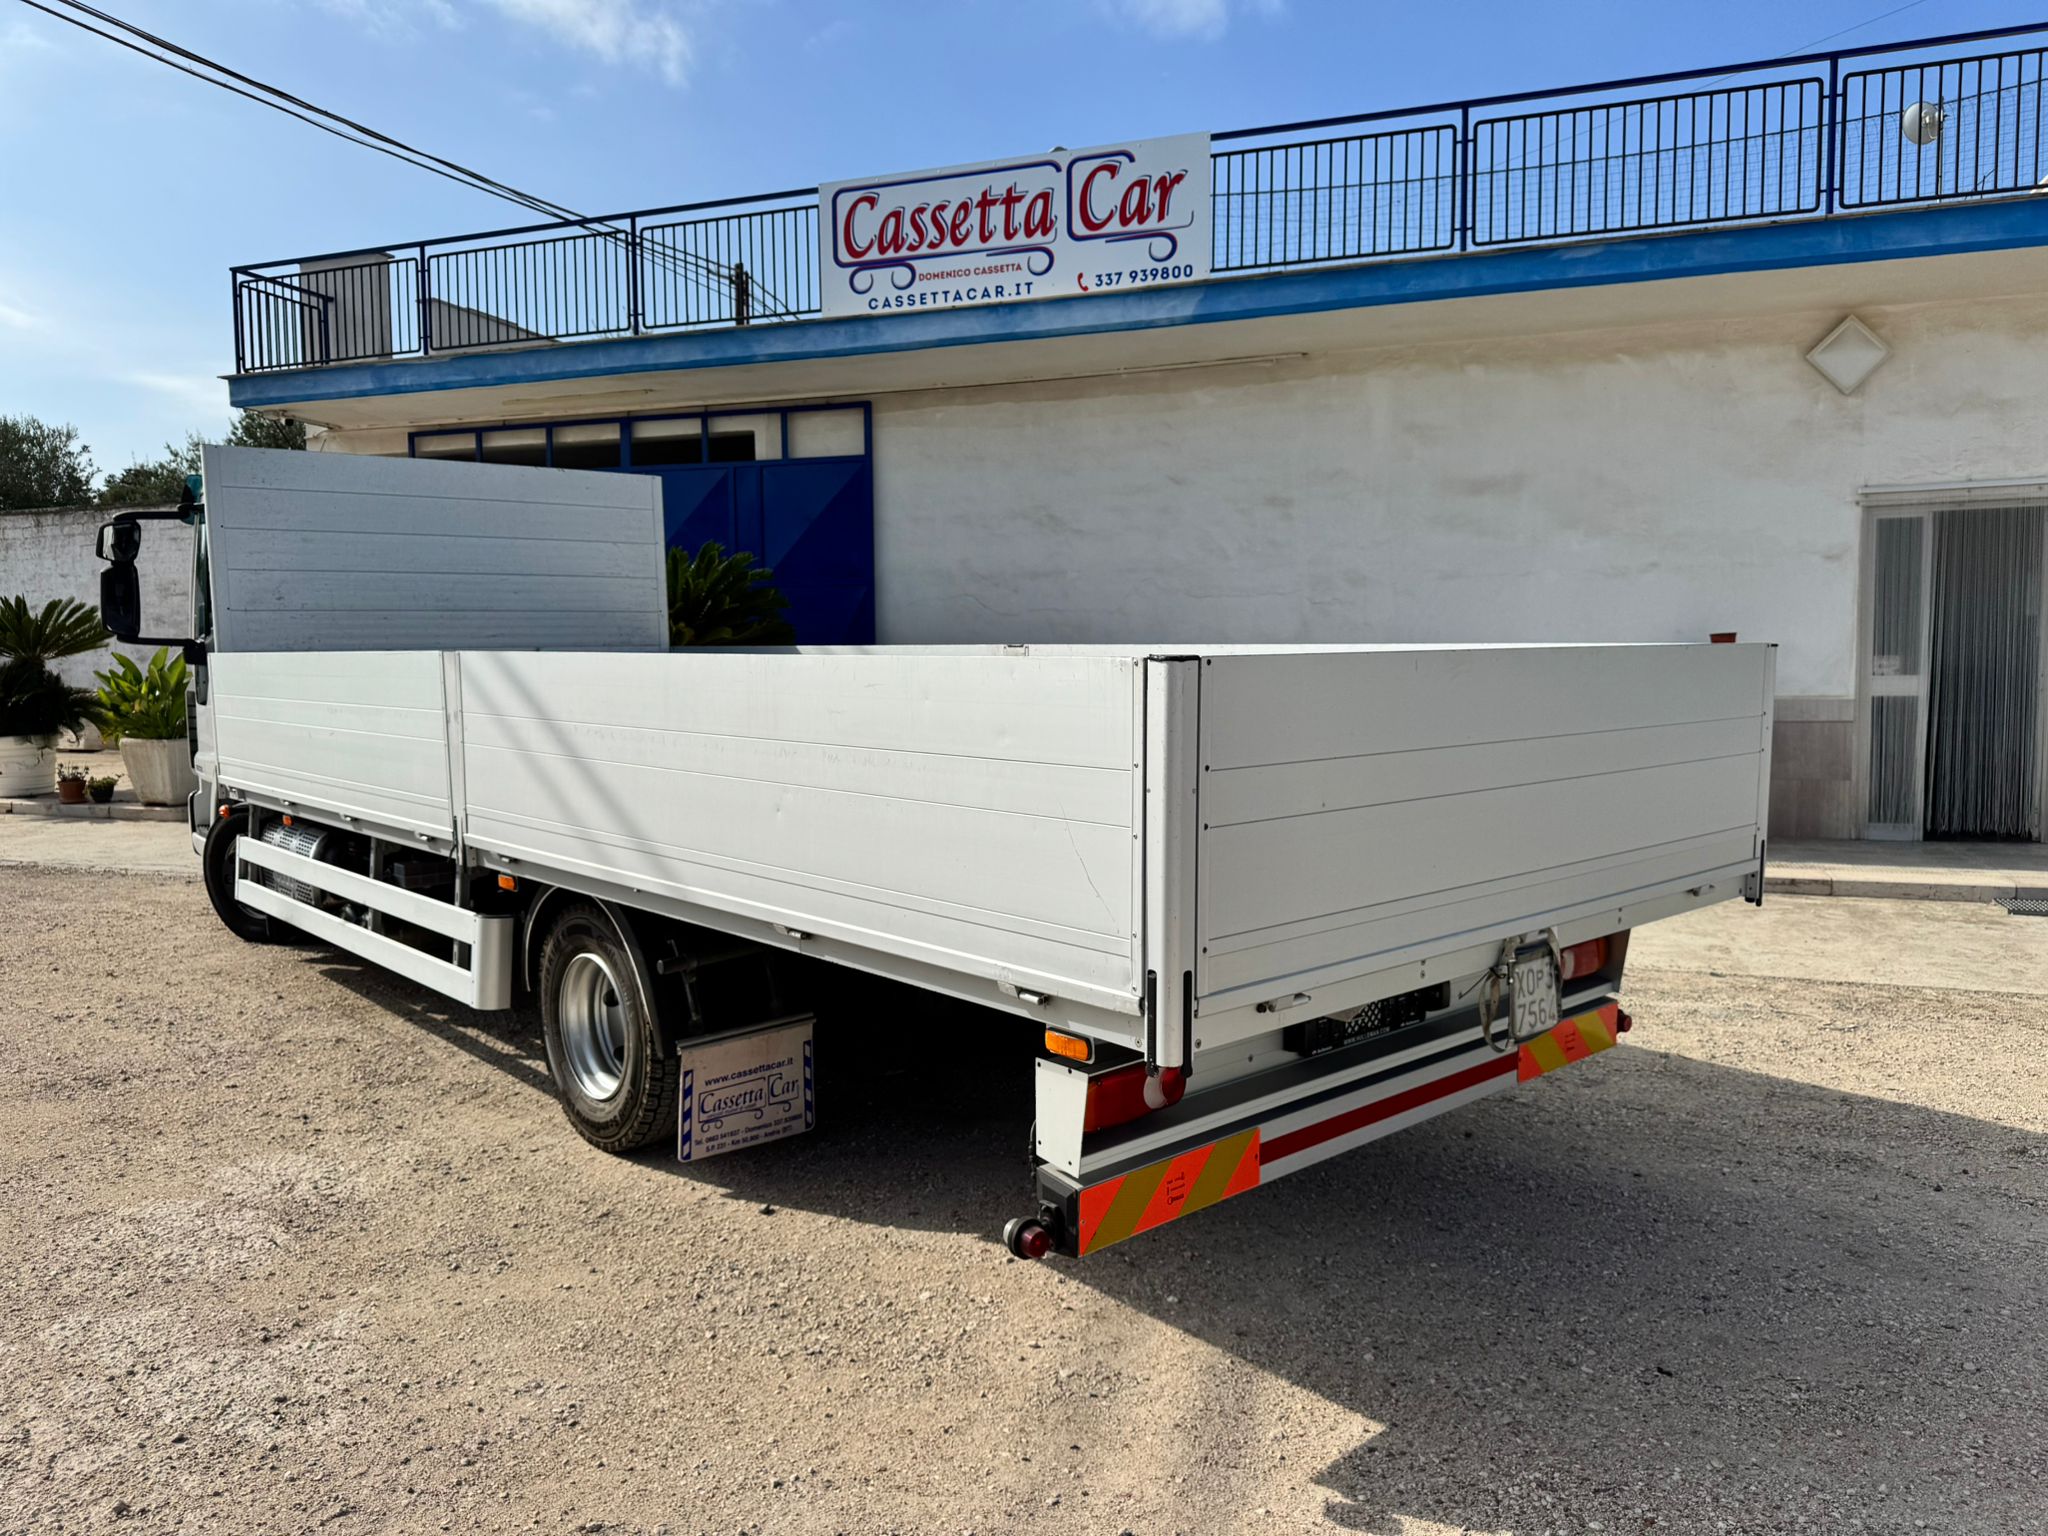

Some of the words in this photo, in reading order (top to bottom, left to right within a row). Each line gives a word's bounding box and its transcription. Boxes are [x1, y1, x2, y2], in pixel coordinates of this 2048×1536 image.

[844, 182, 1057, 259] Cassetta
[1080, 160, 1188, 231] Car
[918, 269, 971, 282] DOMENICO
[974, 263, 1022, 276] CASSETTA
[1095, 271, 1123, 287] 337
[1129, 264, 1194, 283] 939800
[868, 282, 1034, 310] CASSETTACAR.IT
[704, 1057, 793, 1086] www.cassettacar.it
[701, 1087, 764, 1114] Cassetta
[770, 1076, 799, 1098] Car
